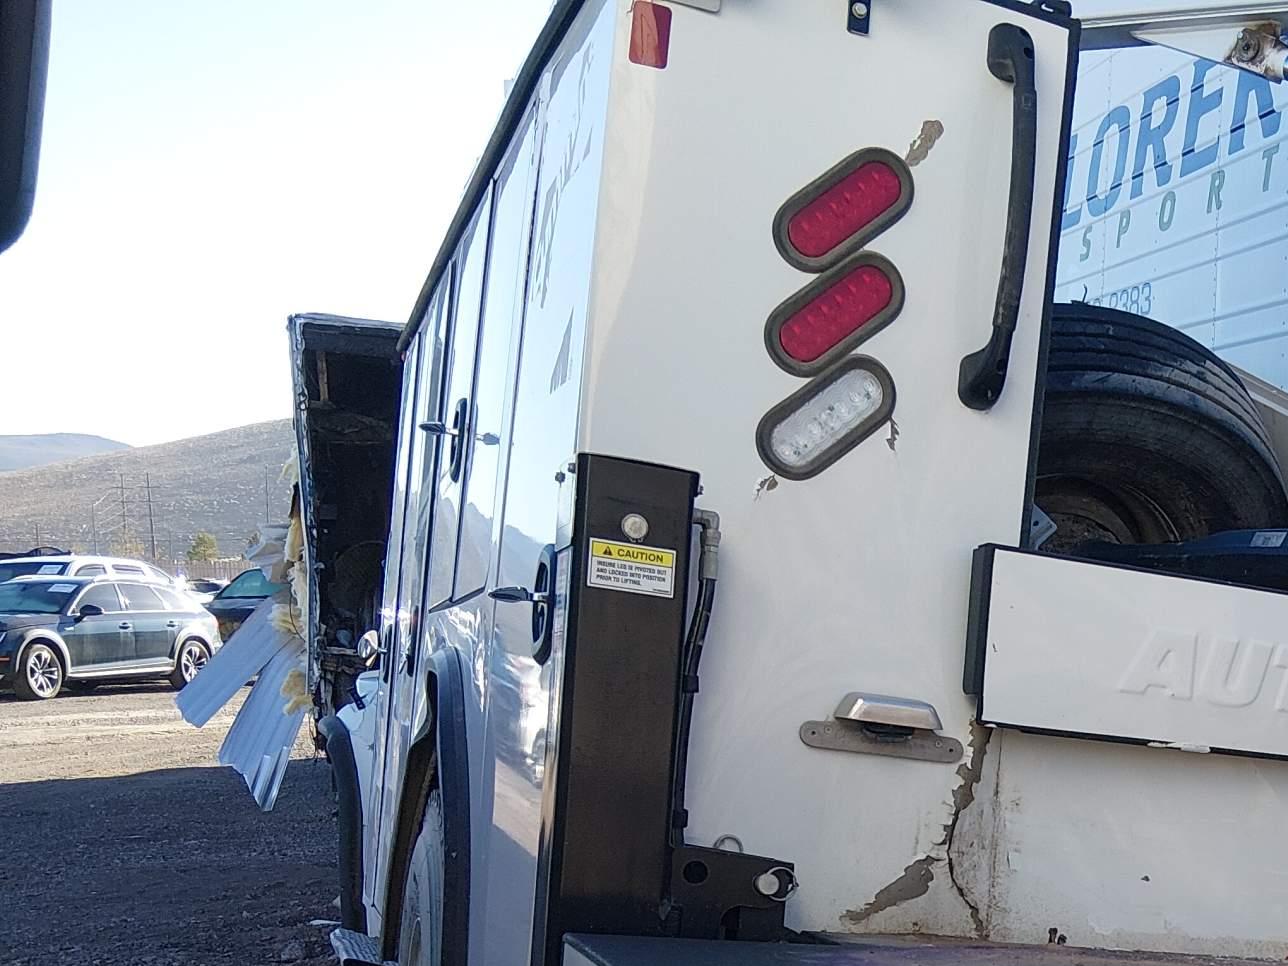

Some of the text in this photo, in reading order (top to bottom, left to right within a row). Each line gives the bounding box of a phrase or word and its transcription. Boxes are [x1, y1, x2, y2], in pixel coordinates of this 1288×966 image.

[617, 548, 664, 563] CAUTION
[596, 574, 612, 582] PRIOR
[608, 568, 629, 577] LOCKED
[642, 573, 666, 583] POSITION
